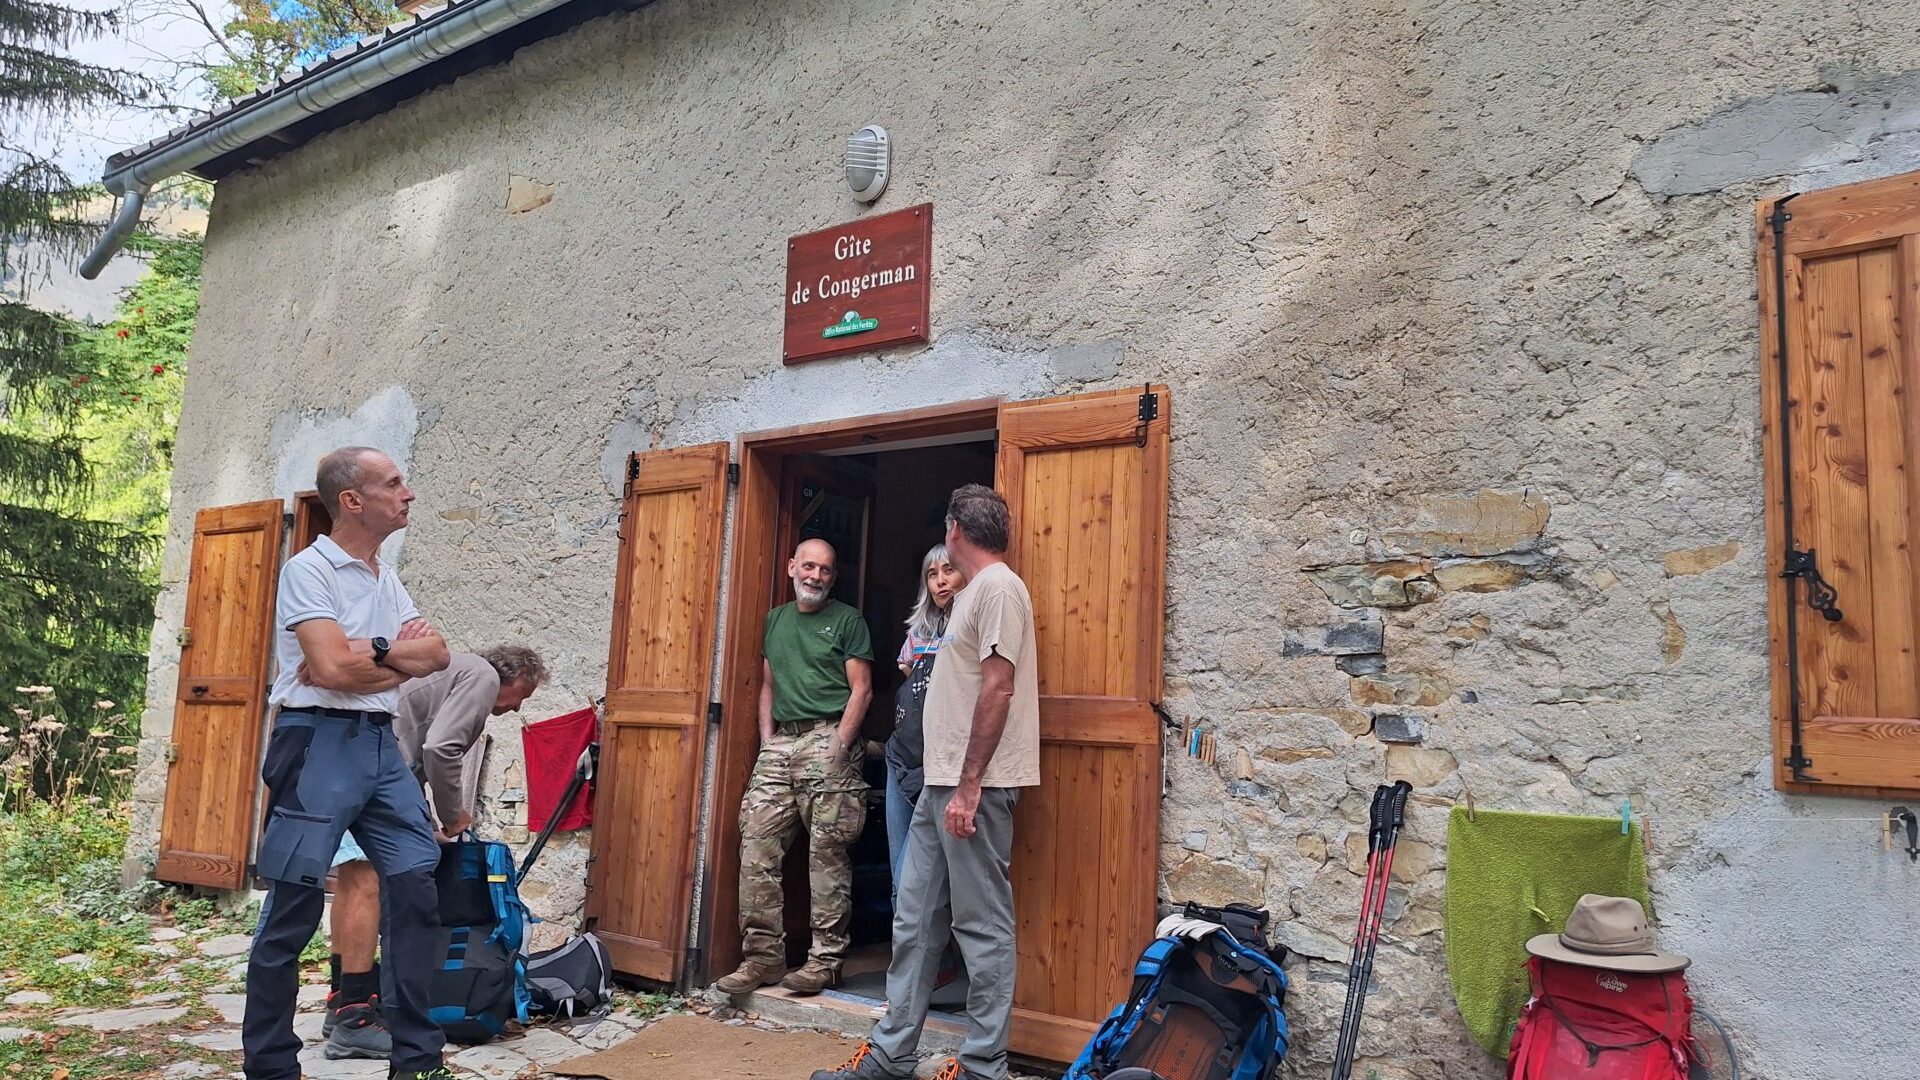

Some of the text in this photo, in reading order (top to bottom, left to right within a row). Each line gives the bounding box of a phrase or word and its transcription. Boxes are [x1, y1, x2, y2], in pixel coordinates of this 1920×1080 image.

[835, 235, 872, 260] Gîte
[792, 264, 915, 305] de Congerman
